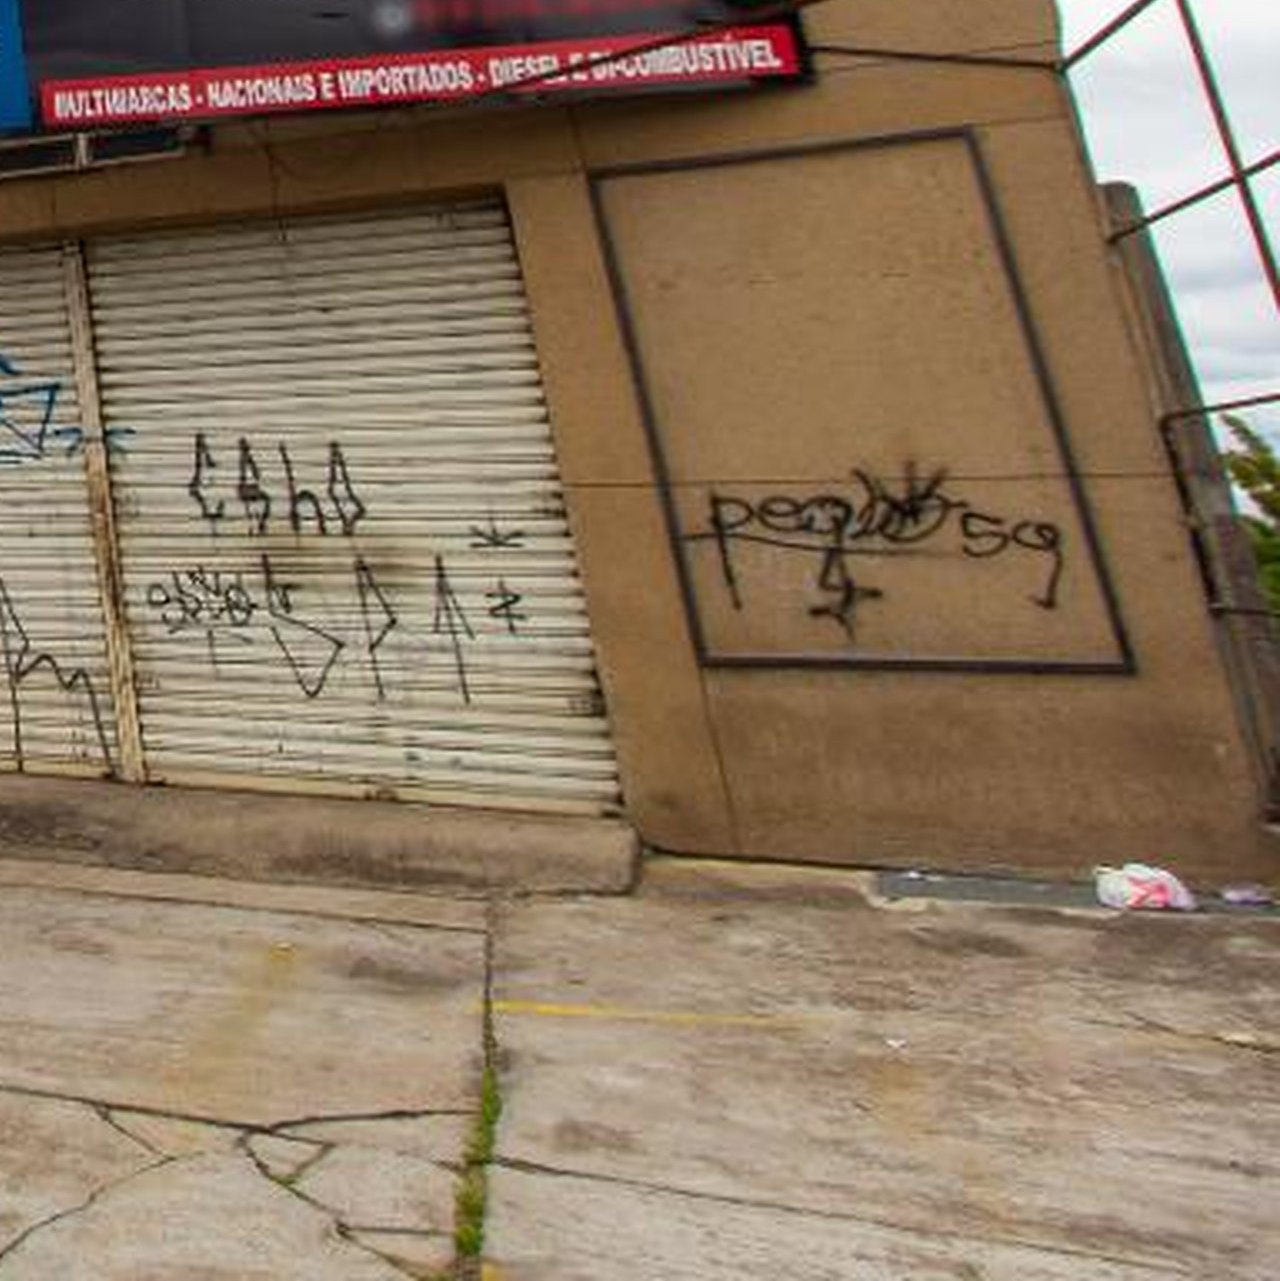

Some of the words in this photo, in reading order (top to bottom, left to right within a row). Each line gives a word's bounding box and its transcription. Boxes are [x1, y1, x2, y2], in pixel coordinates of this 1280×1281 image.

[208, 74, 316, 110] NACIONAIS
[321, 73, 336, 100] E
[338, 59, 474, 100] IMPORTADOS
[488, 55, 567, 89] DIESEL
